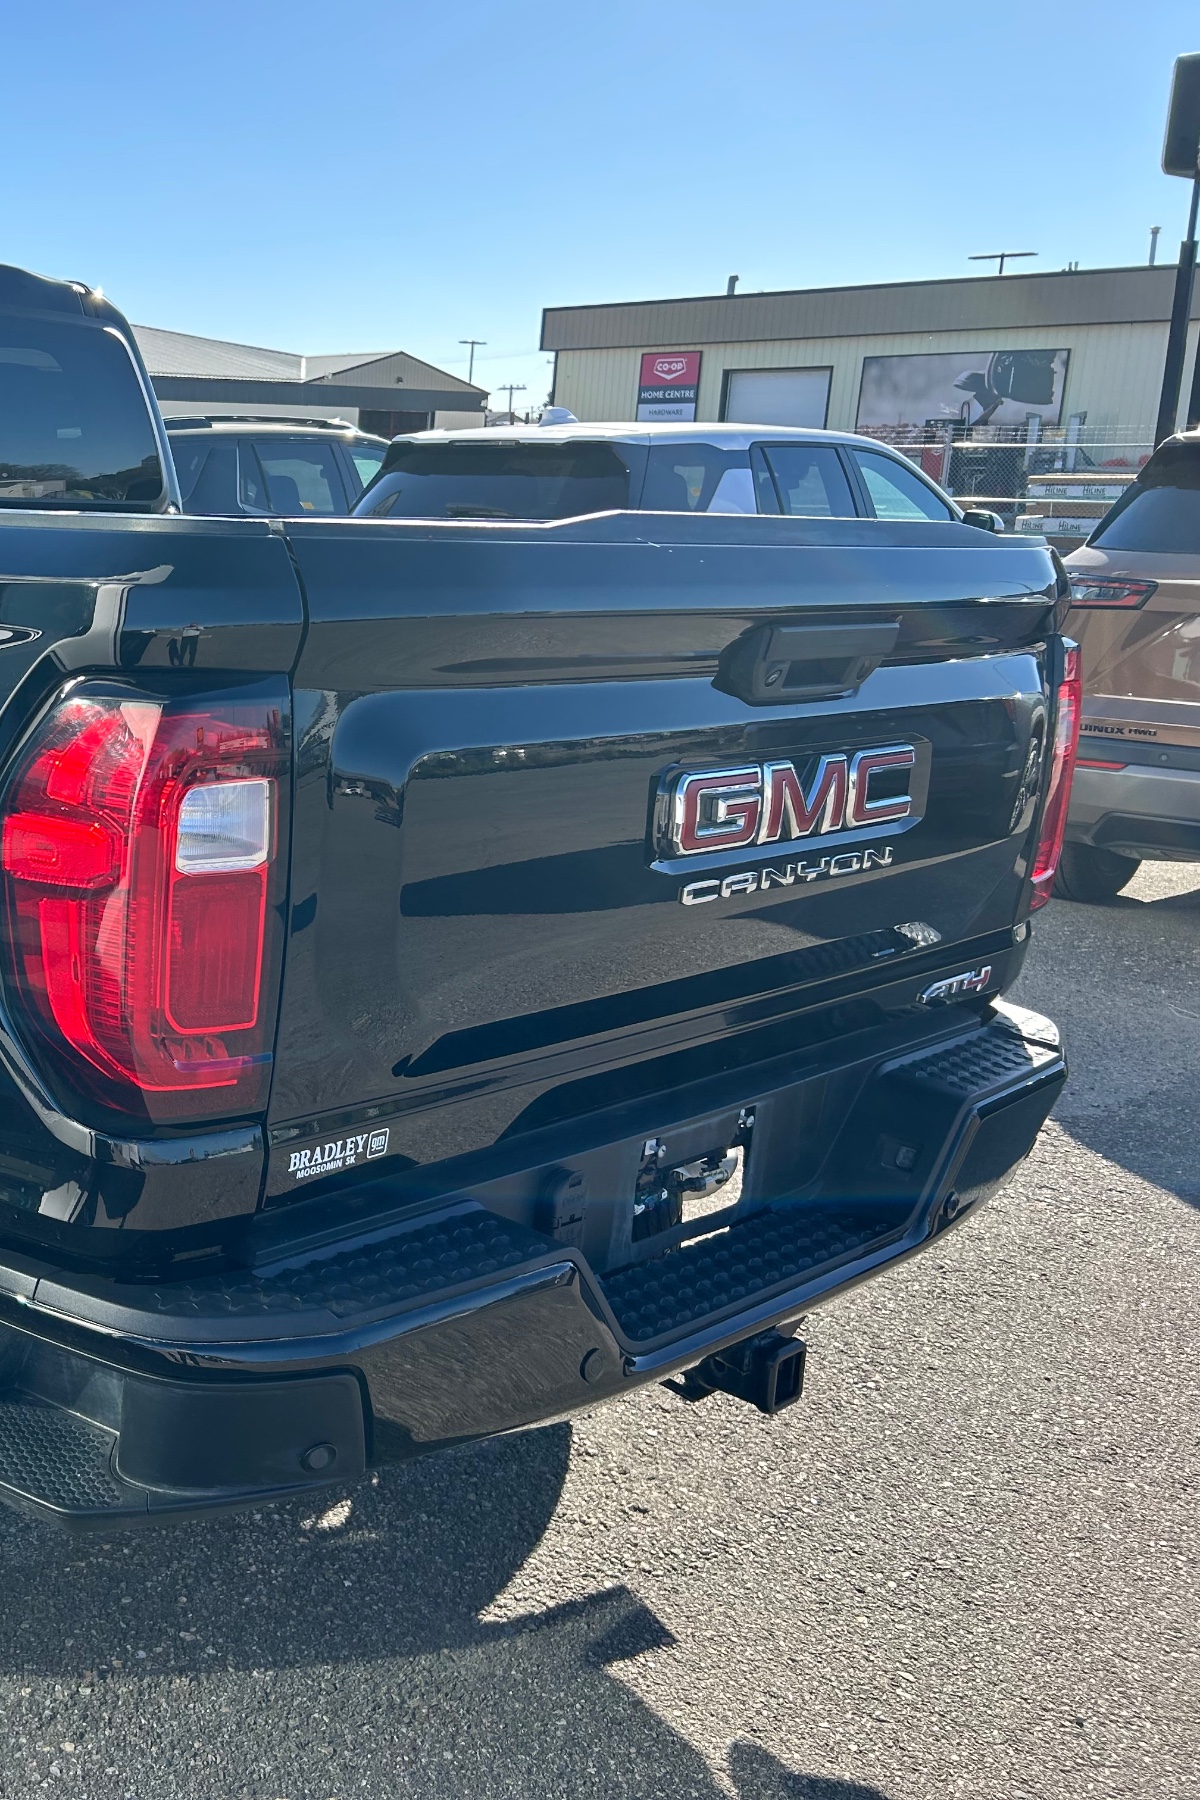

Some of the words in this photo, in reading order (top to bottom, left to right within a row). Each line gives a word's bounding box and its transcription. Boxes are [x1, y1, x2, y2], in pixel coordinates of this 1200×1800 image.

[665, 390, 694, 398] CENTRE
[673, 743, 915, 856] GMC
[679, 846, 894, 906] CANYON
[920, 965, 992, 1004] AT4
[288, 1134, 368, 1172] BRADLEY
[296, 1159, 343, 1179] MOOSOMIN
[345, 1155, 356, 1166] SK
